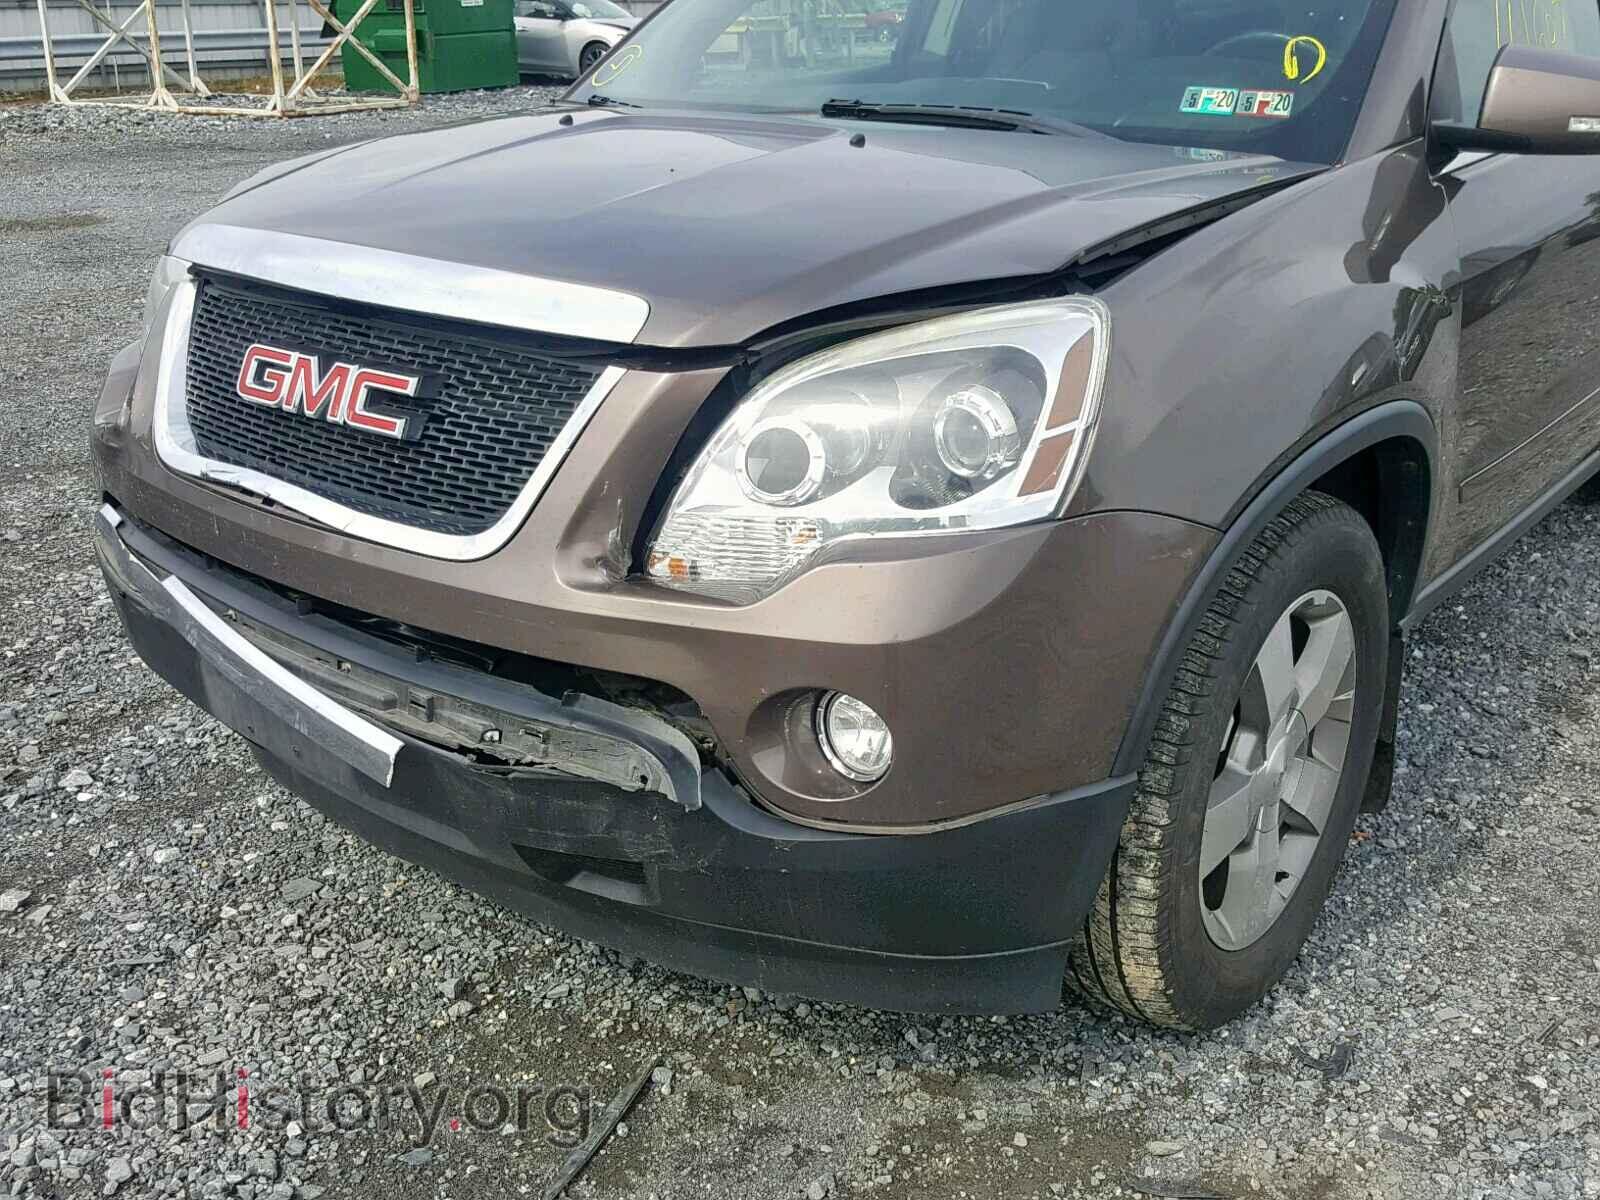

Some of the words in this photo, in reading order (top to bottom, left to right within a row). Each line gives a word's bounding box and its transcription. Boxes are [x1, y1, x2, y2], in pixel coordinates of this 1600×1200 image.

[1189, 93, 1199, 108] 5
[1217, 91, 1236, 107] 20
[1245, 97, 1254, 112] 5
[1274, 94, 1291, 112] 20
[236, 343, 421, 439] GMC
